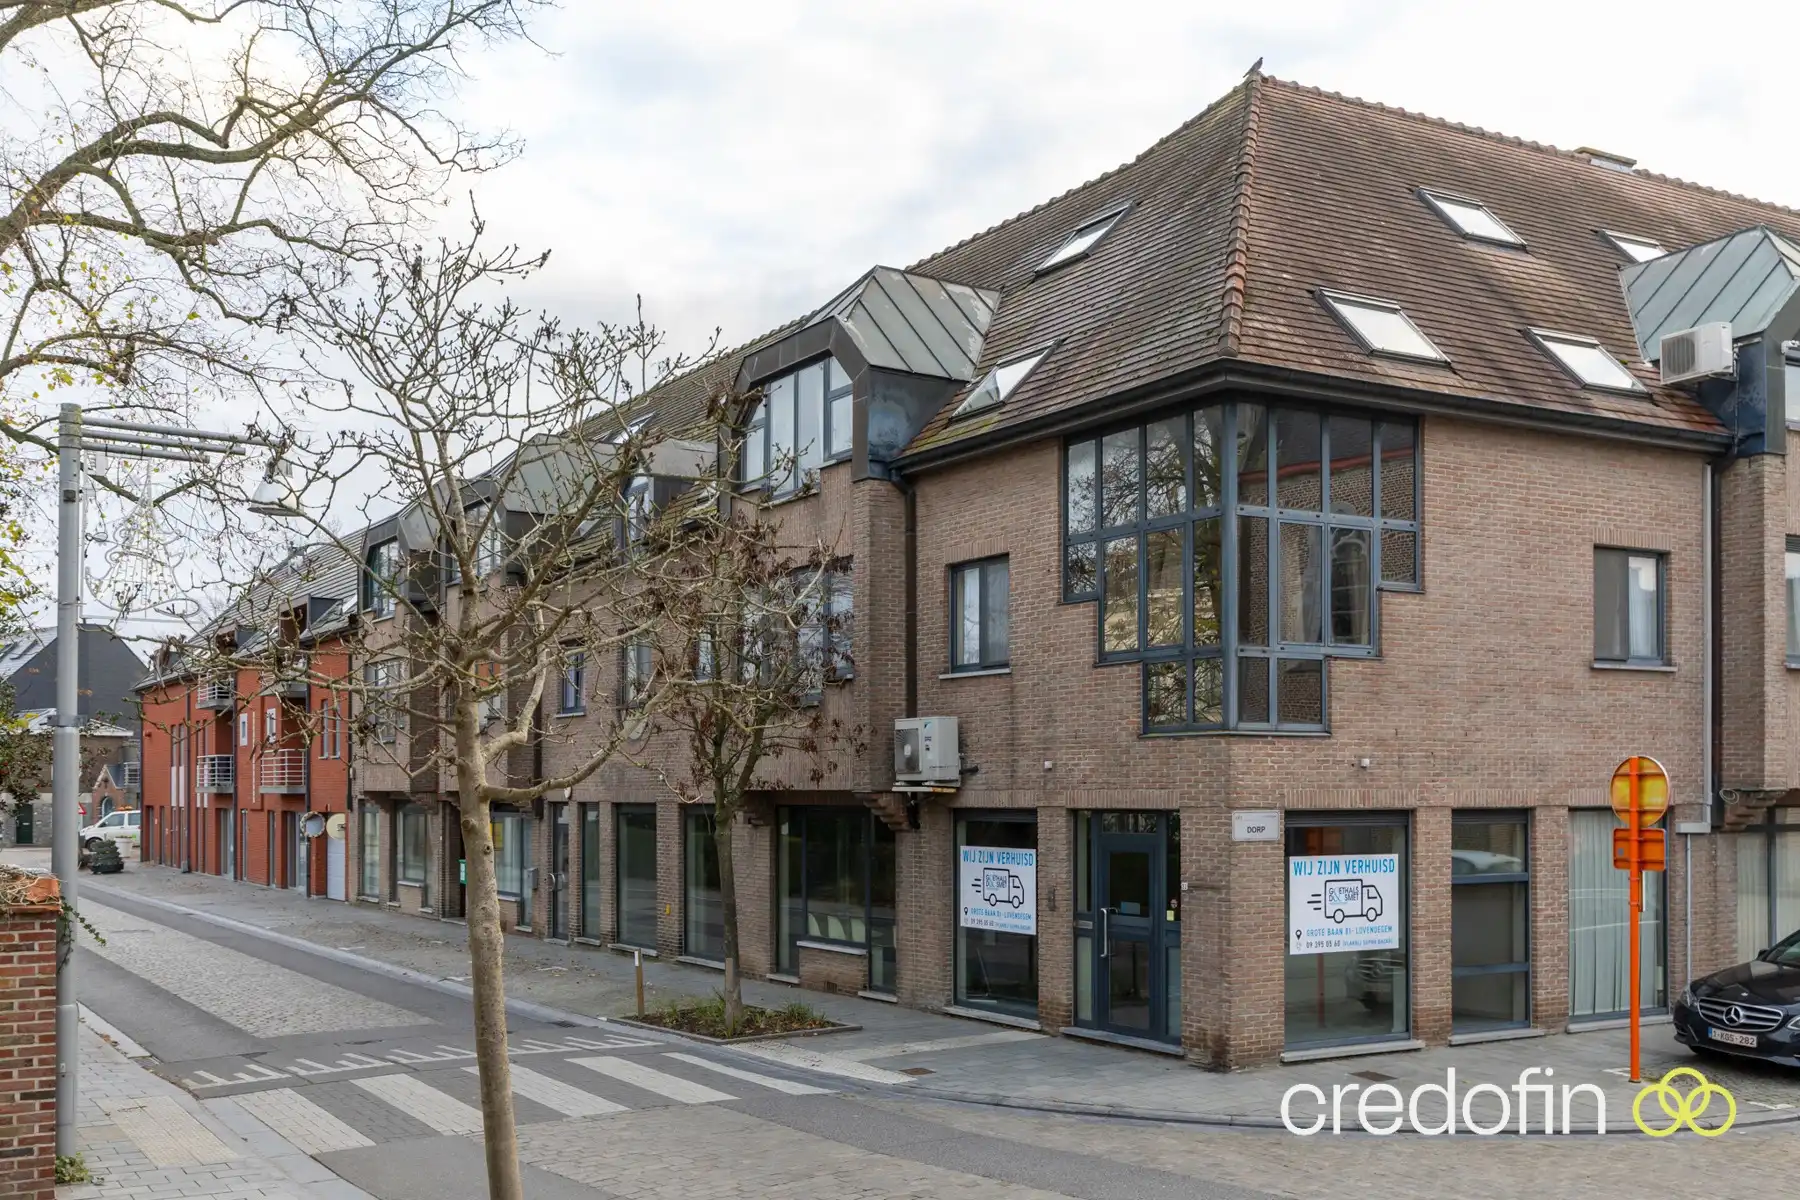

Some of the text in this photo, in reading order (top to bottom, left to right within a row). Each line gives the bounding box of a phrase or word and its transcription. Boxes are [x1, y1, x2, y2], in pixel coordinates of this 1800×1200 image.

[1246, 825, 1266, 834] DORP
[962, 850, 1034, 867] WIJ ZIJN VERHUISD
[1293, 858, 1395, 876] WIJ ZIJN VERHUISD
[1306, 928, 1325, 937] GROTE
[1327, 927, 1343, 936] BAAN
[1355, 925, 1393, 934] LOVENDEGEM
[1314, 940, 1324, 948] 395
[1326, 940, 1332, 948] 05
[1713, 1030, 1755, 1046] 1-KGS-282
